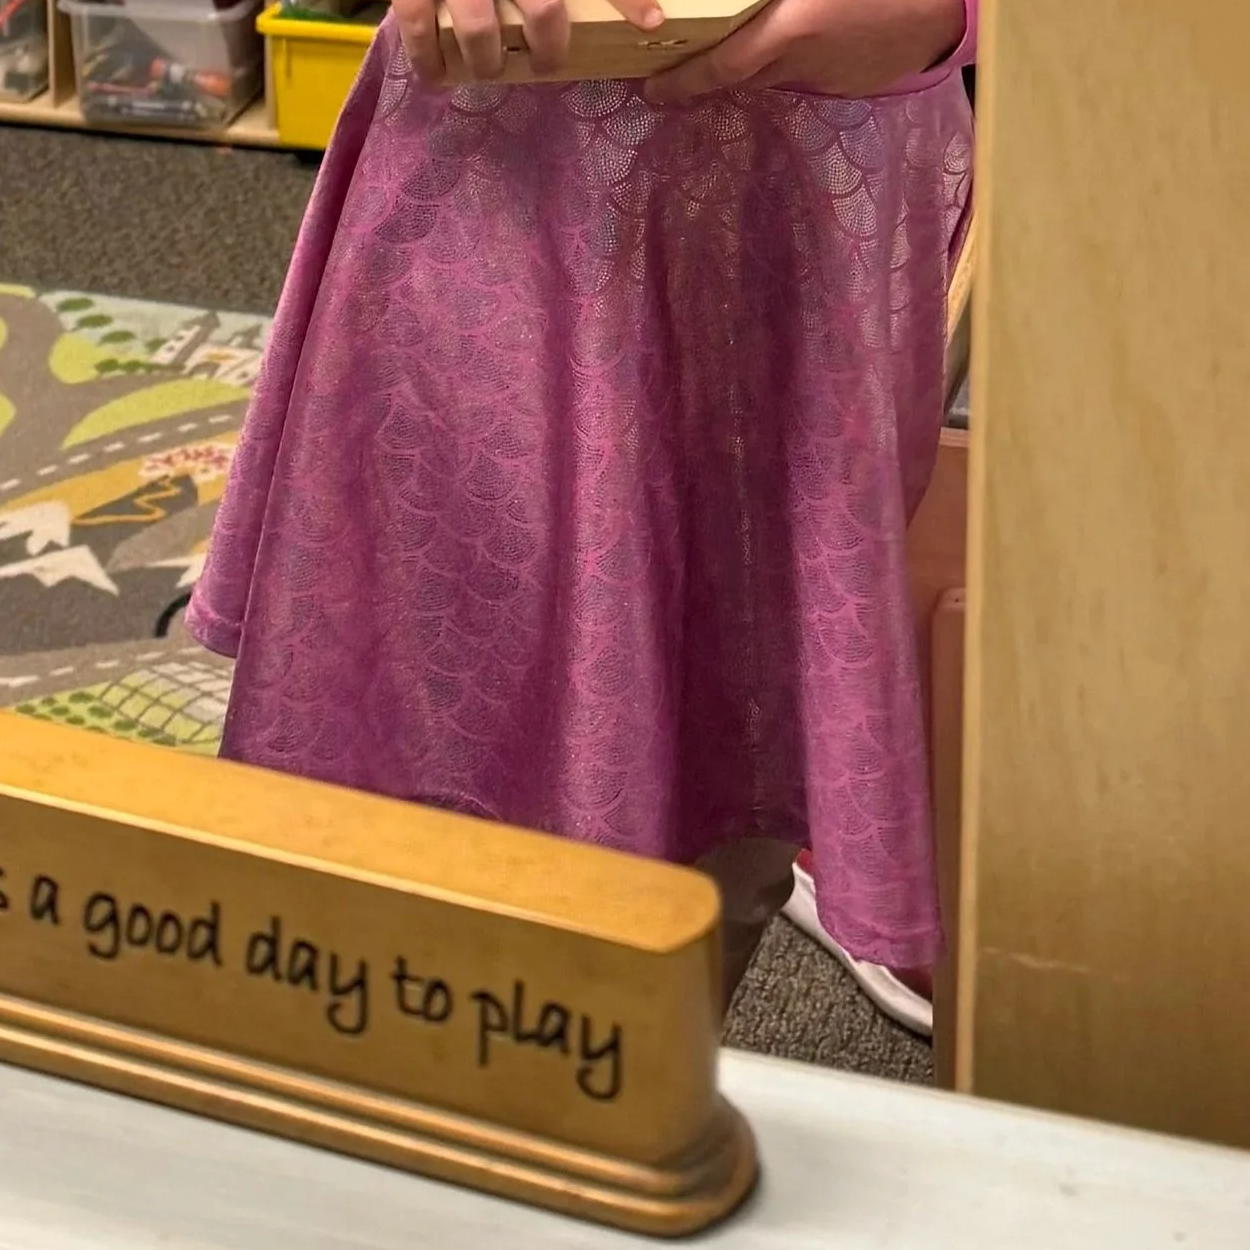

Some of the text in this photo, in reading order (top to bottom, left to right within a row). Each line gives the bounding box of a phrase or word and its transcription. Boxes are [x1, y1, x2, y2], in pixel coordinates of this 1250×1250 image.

[30, 874, 61, 926] a
[83, 891, 223, 968] good
[247, 916, 369, 1036] day
[389, 955, 453, 1024] to
[470, 978, 623, 1102] play
